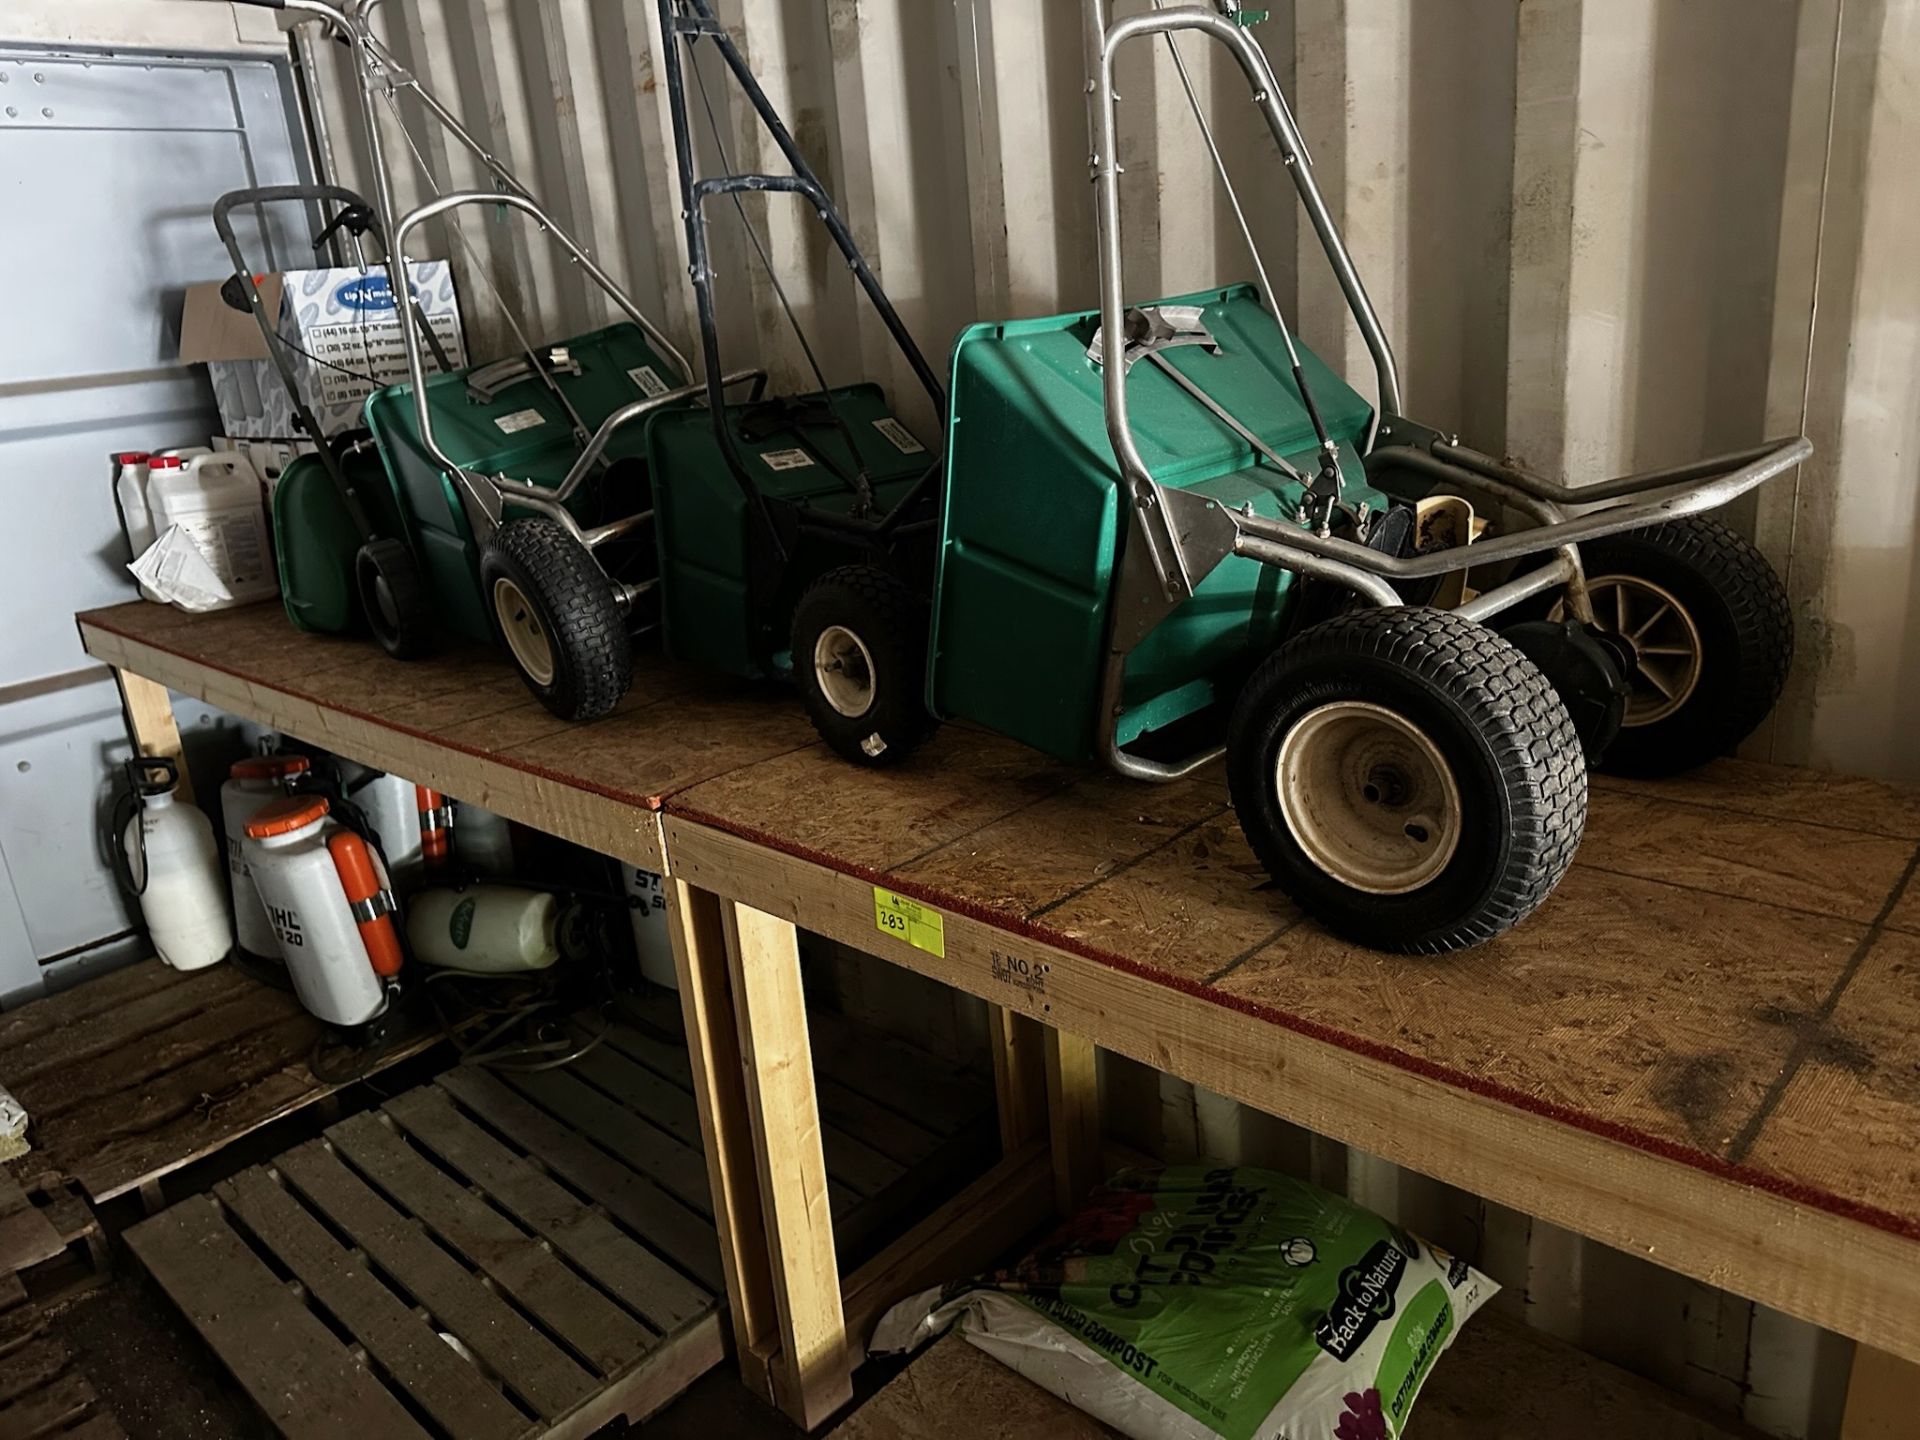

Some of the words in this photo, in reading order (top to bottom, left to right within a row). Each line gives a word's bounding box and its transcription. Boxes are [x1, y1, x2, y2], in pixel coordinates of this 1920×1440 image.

[323, 328, 337, 339] (44)
[338, 327, 348, 336] 16
[342, 342, 352, 350] 32
[345, 357, 354, 366] 64
[880, 911, 905, 931] 283
[286, 931, 303, 947] 20
[1360, 1247, 1401, 1299] Nature
[1356, 1290, 1372, 1309] to
[1050, 1298, 1087, 1331] BURR
[1084, 1320, 1159, 1379] COMPOST
[1325, 1303, 1368, 1356] Back
[1156, 1370, 1173, 1387] FOR
[1391, 1366, 1416, 1419] COTTON
